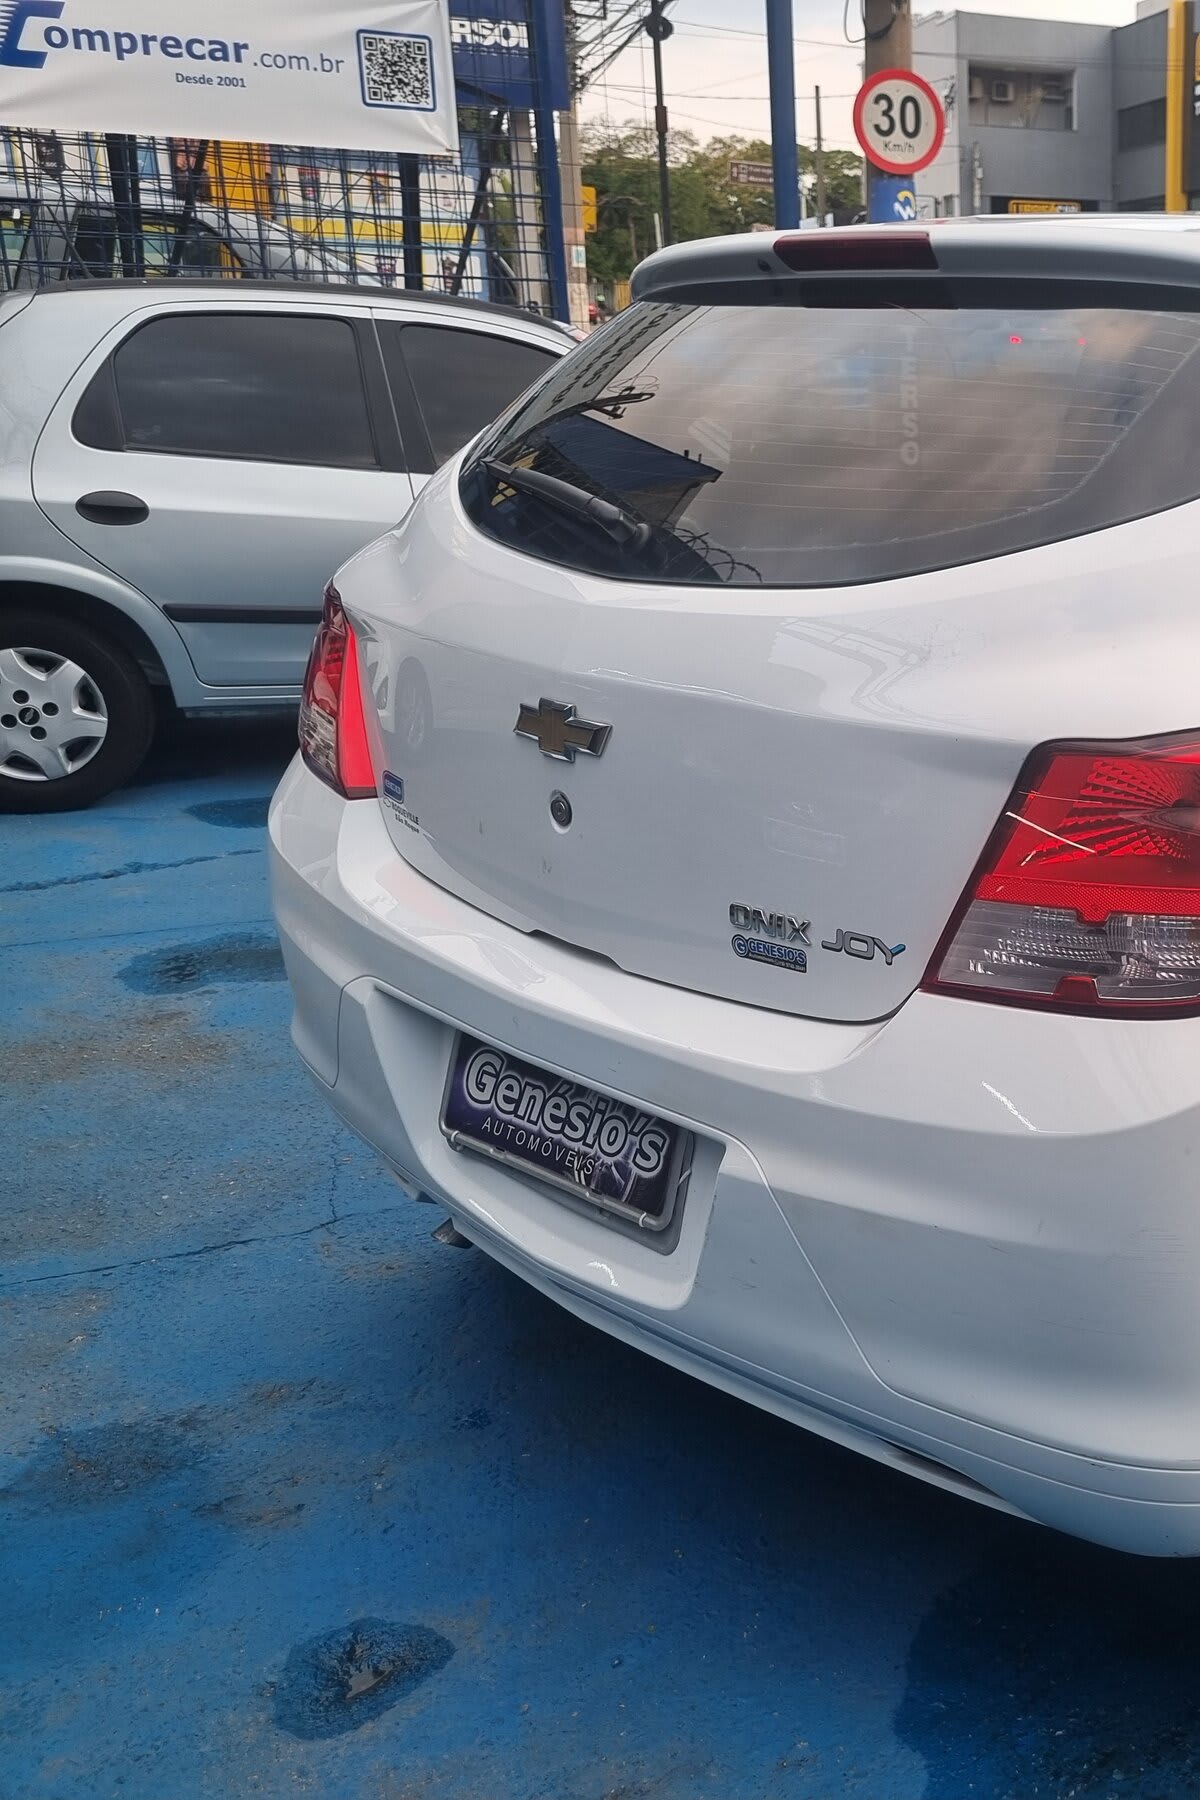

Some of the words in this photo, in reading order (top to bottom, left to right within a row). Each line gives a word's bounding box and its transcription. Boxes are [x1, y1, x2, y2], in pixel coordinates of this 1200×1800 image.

[175, 72, 213, 86] Desde
[216, 75, 247, 88] 2001
[873, 93, 922, 138] 30
[729, 902, 811, 946] ONIX
[821, 928, 906, 966] JOY
[747, 939, 807, 966] GENESIO'S
[466, 1049, 668, 1174] Genésio's
[481, 1115, 597, 1176] AUTOMÓVEIS
